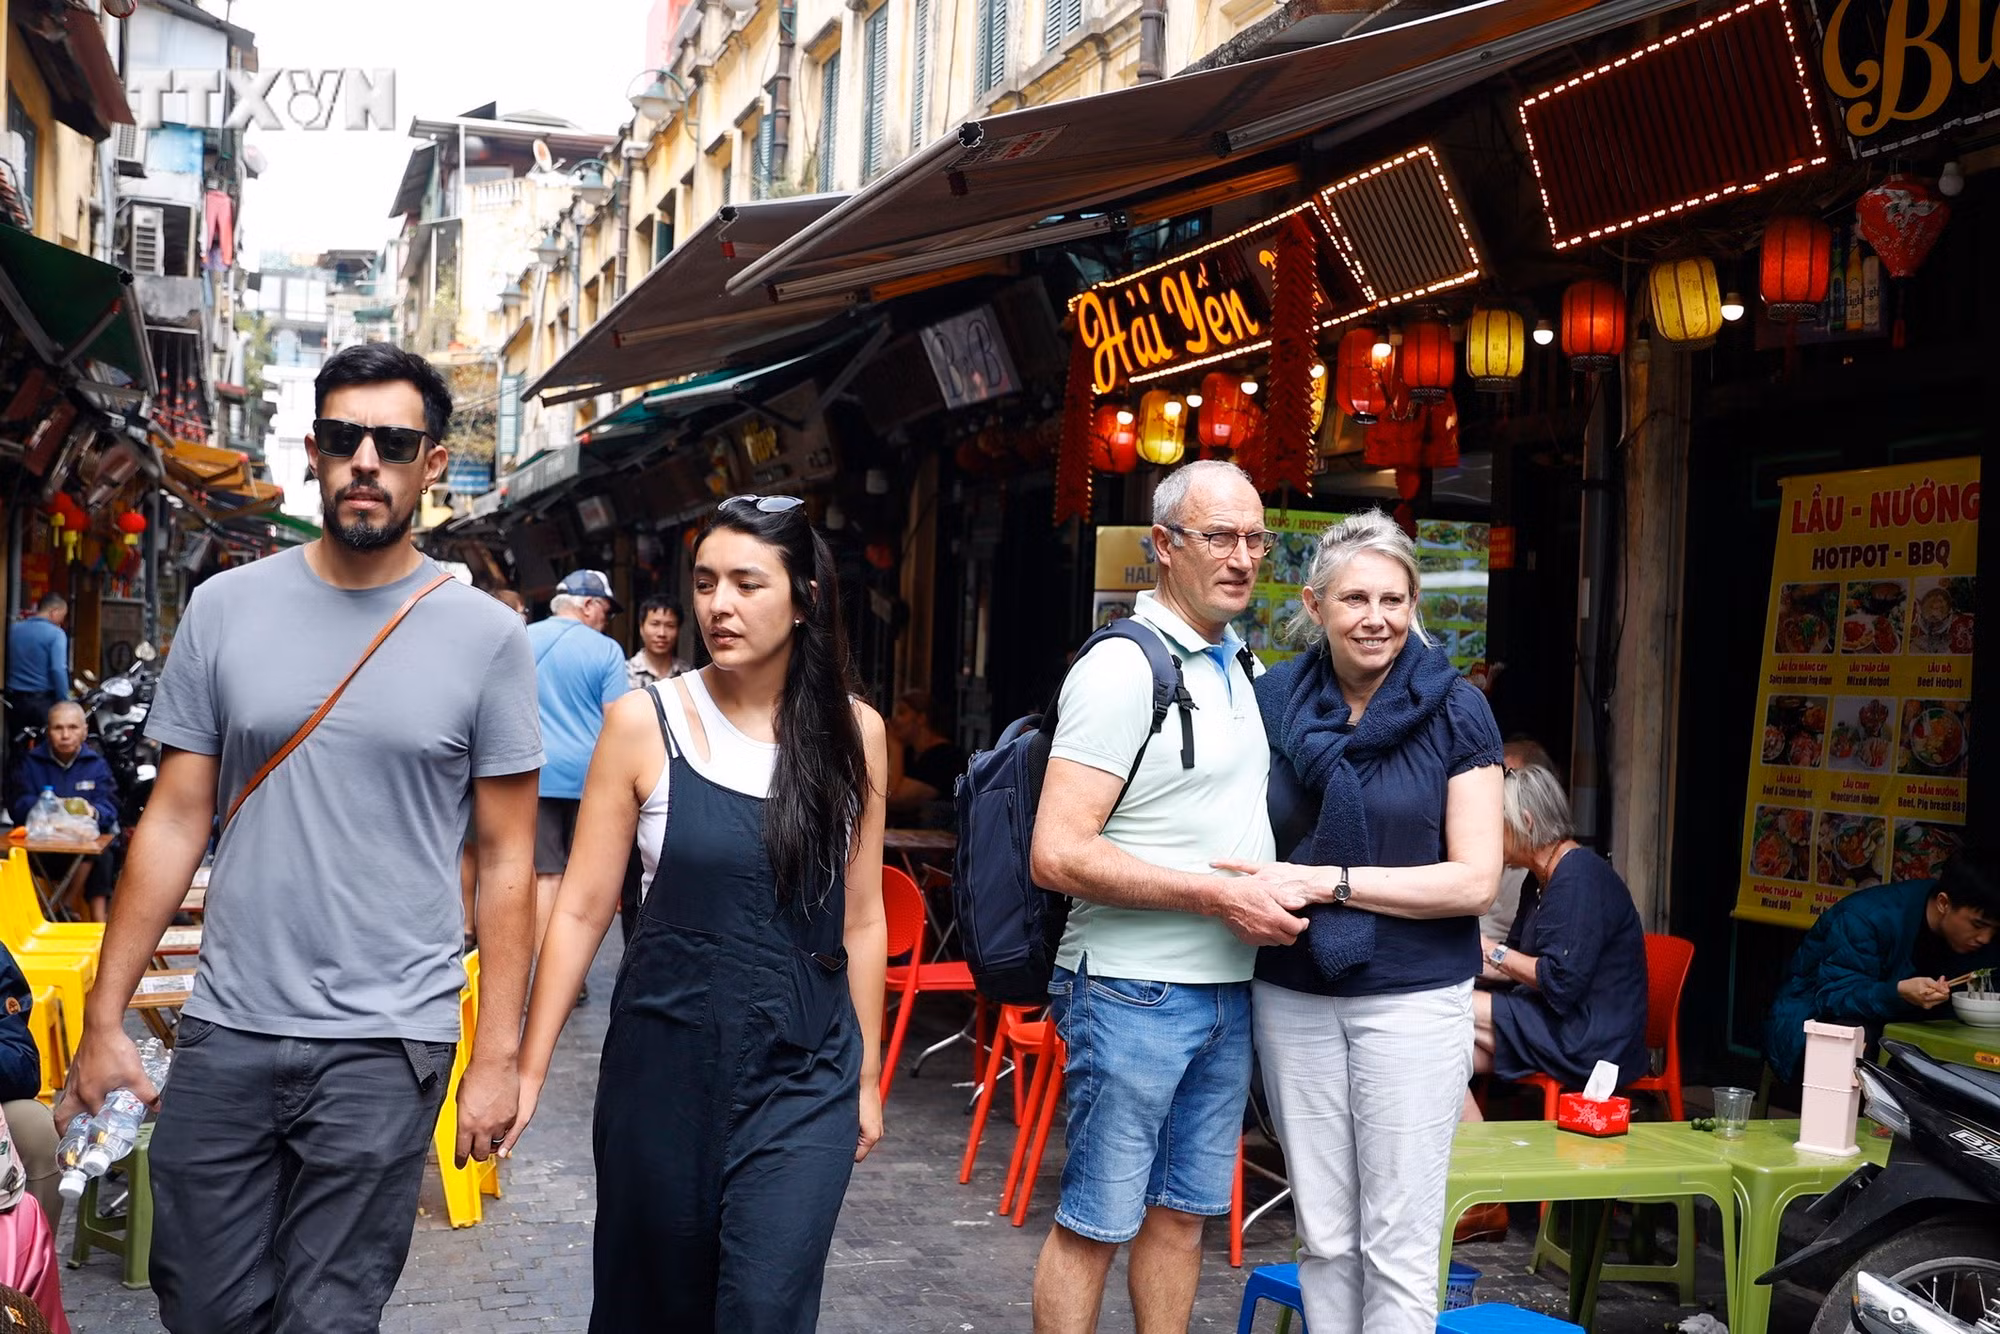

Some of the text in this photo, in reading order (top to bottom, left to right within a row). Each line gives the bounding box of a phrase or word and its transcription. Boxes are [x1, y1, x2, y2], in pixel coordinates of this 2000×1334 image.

[1792, 484, 1844, 533] LẨU
[1870, 478, 1981, 528] NƯỚNG
[1812, 544, 1889, 570] HOTPOT
[1908, 540, 1949, 569] BBQ
[1125, 566, 1159, 584] HAL
[1846, 676, 1890, 687] Mixed Hotpot
[1917, 676, 1962, 689] Beef Hotpot
